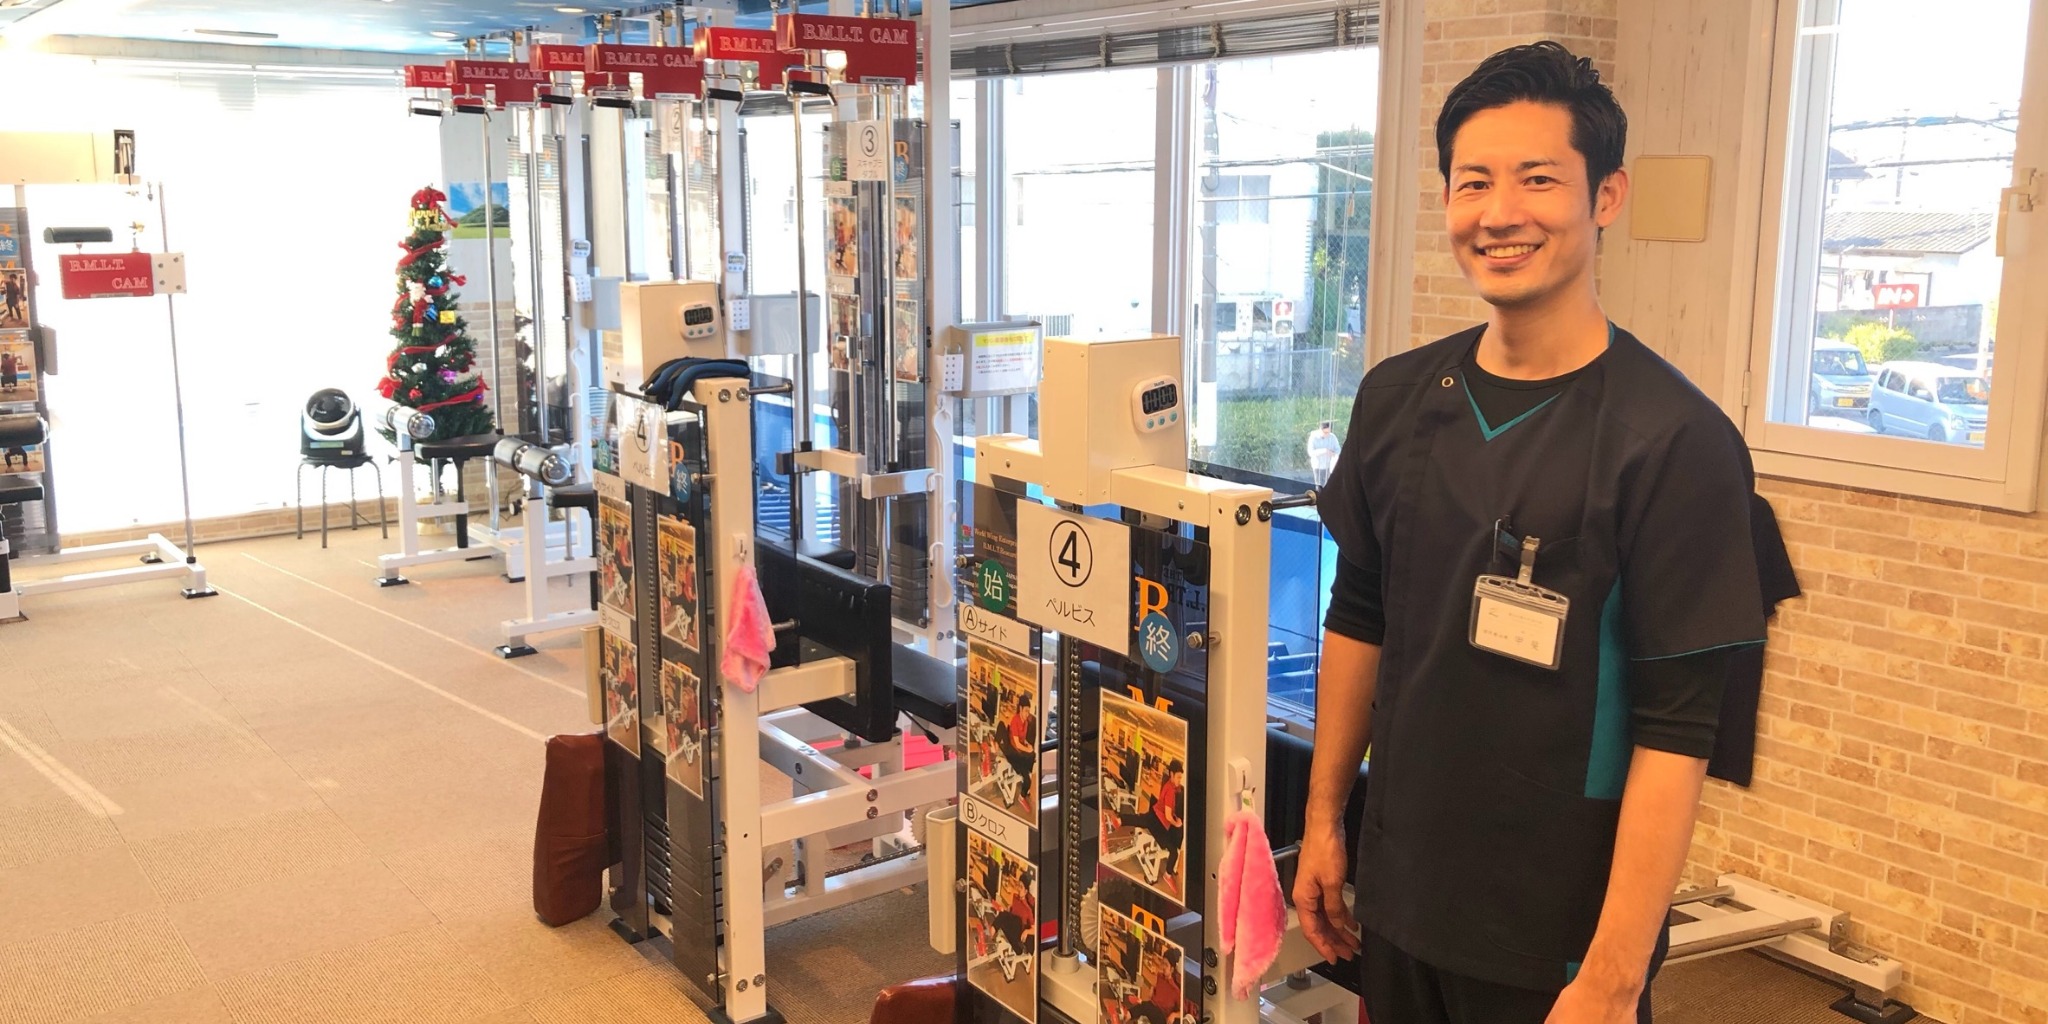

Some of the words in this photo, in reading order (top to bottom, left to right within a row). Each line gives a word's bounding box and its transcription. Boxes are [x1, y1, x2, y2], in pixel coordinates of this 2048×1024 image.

[803, 23, 863, 42] B.M.L.T.
[870, 28, 909, 44] CAM
[605, 51, 659, 66] B.M.L.T.
[663, 54, 697, 67] CAM
[513, 69, 544, 80] CAM
[69, 258, 126, 272] B.M.L.T.
[111, 276, 149, 289] CAM
[1877, 287, 1903, 305] IN
[984, 567, 1003, 602] 始
[1046, 598, 1095, 628] ペルビス
[1145, 621, 1171, 661] 終
